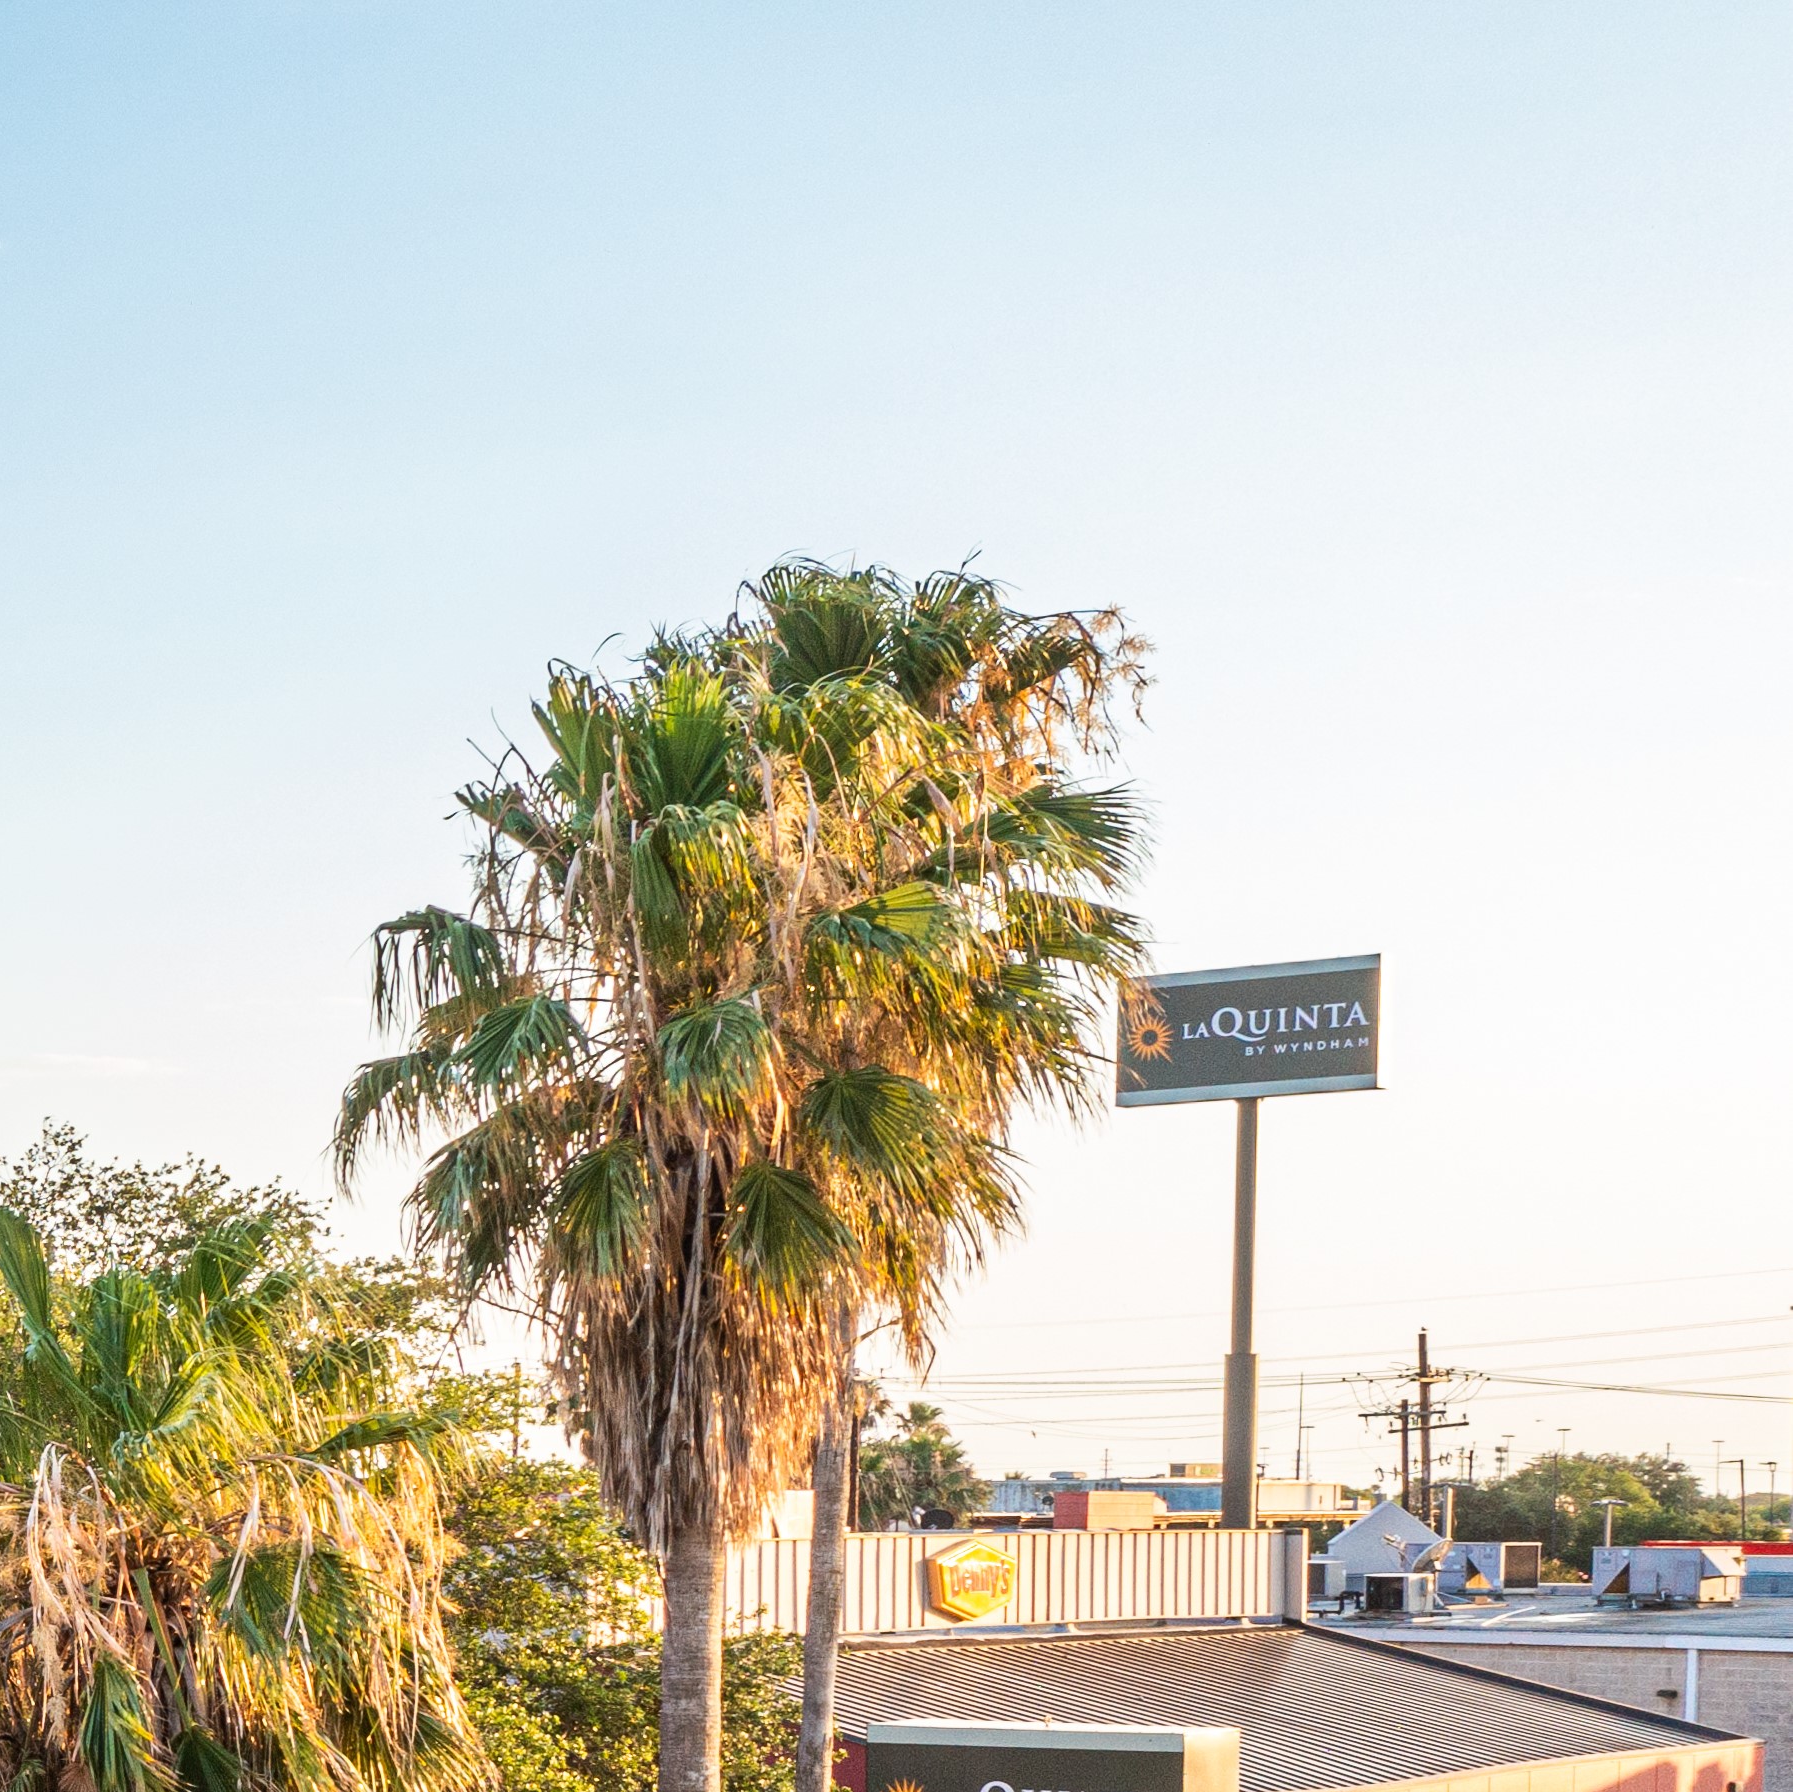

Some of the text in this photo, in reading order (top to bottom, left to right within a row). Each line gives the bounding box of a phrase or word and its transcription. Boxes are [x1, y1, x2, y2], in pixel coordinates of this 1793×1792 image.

[1245, 1037, 1369, 1056] BY WYNDHAM
[950, 1559, 1010, 1598] Denny's
